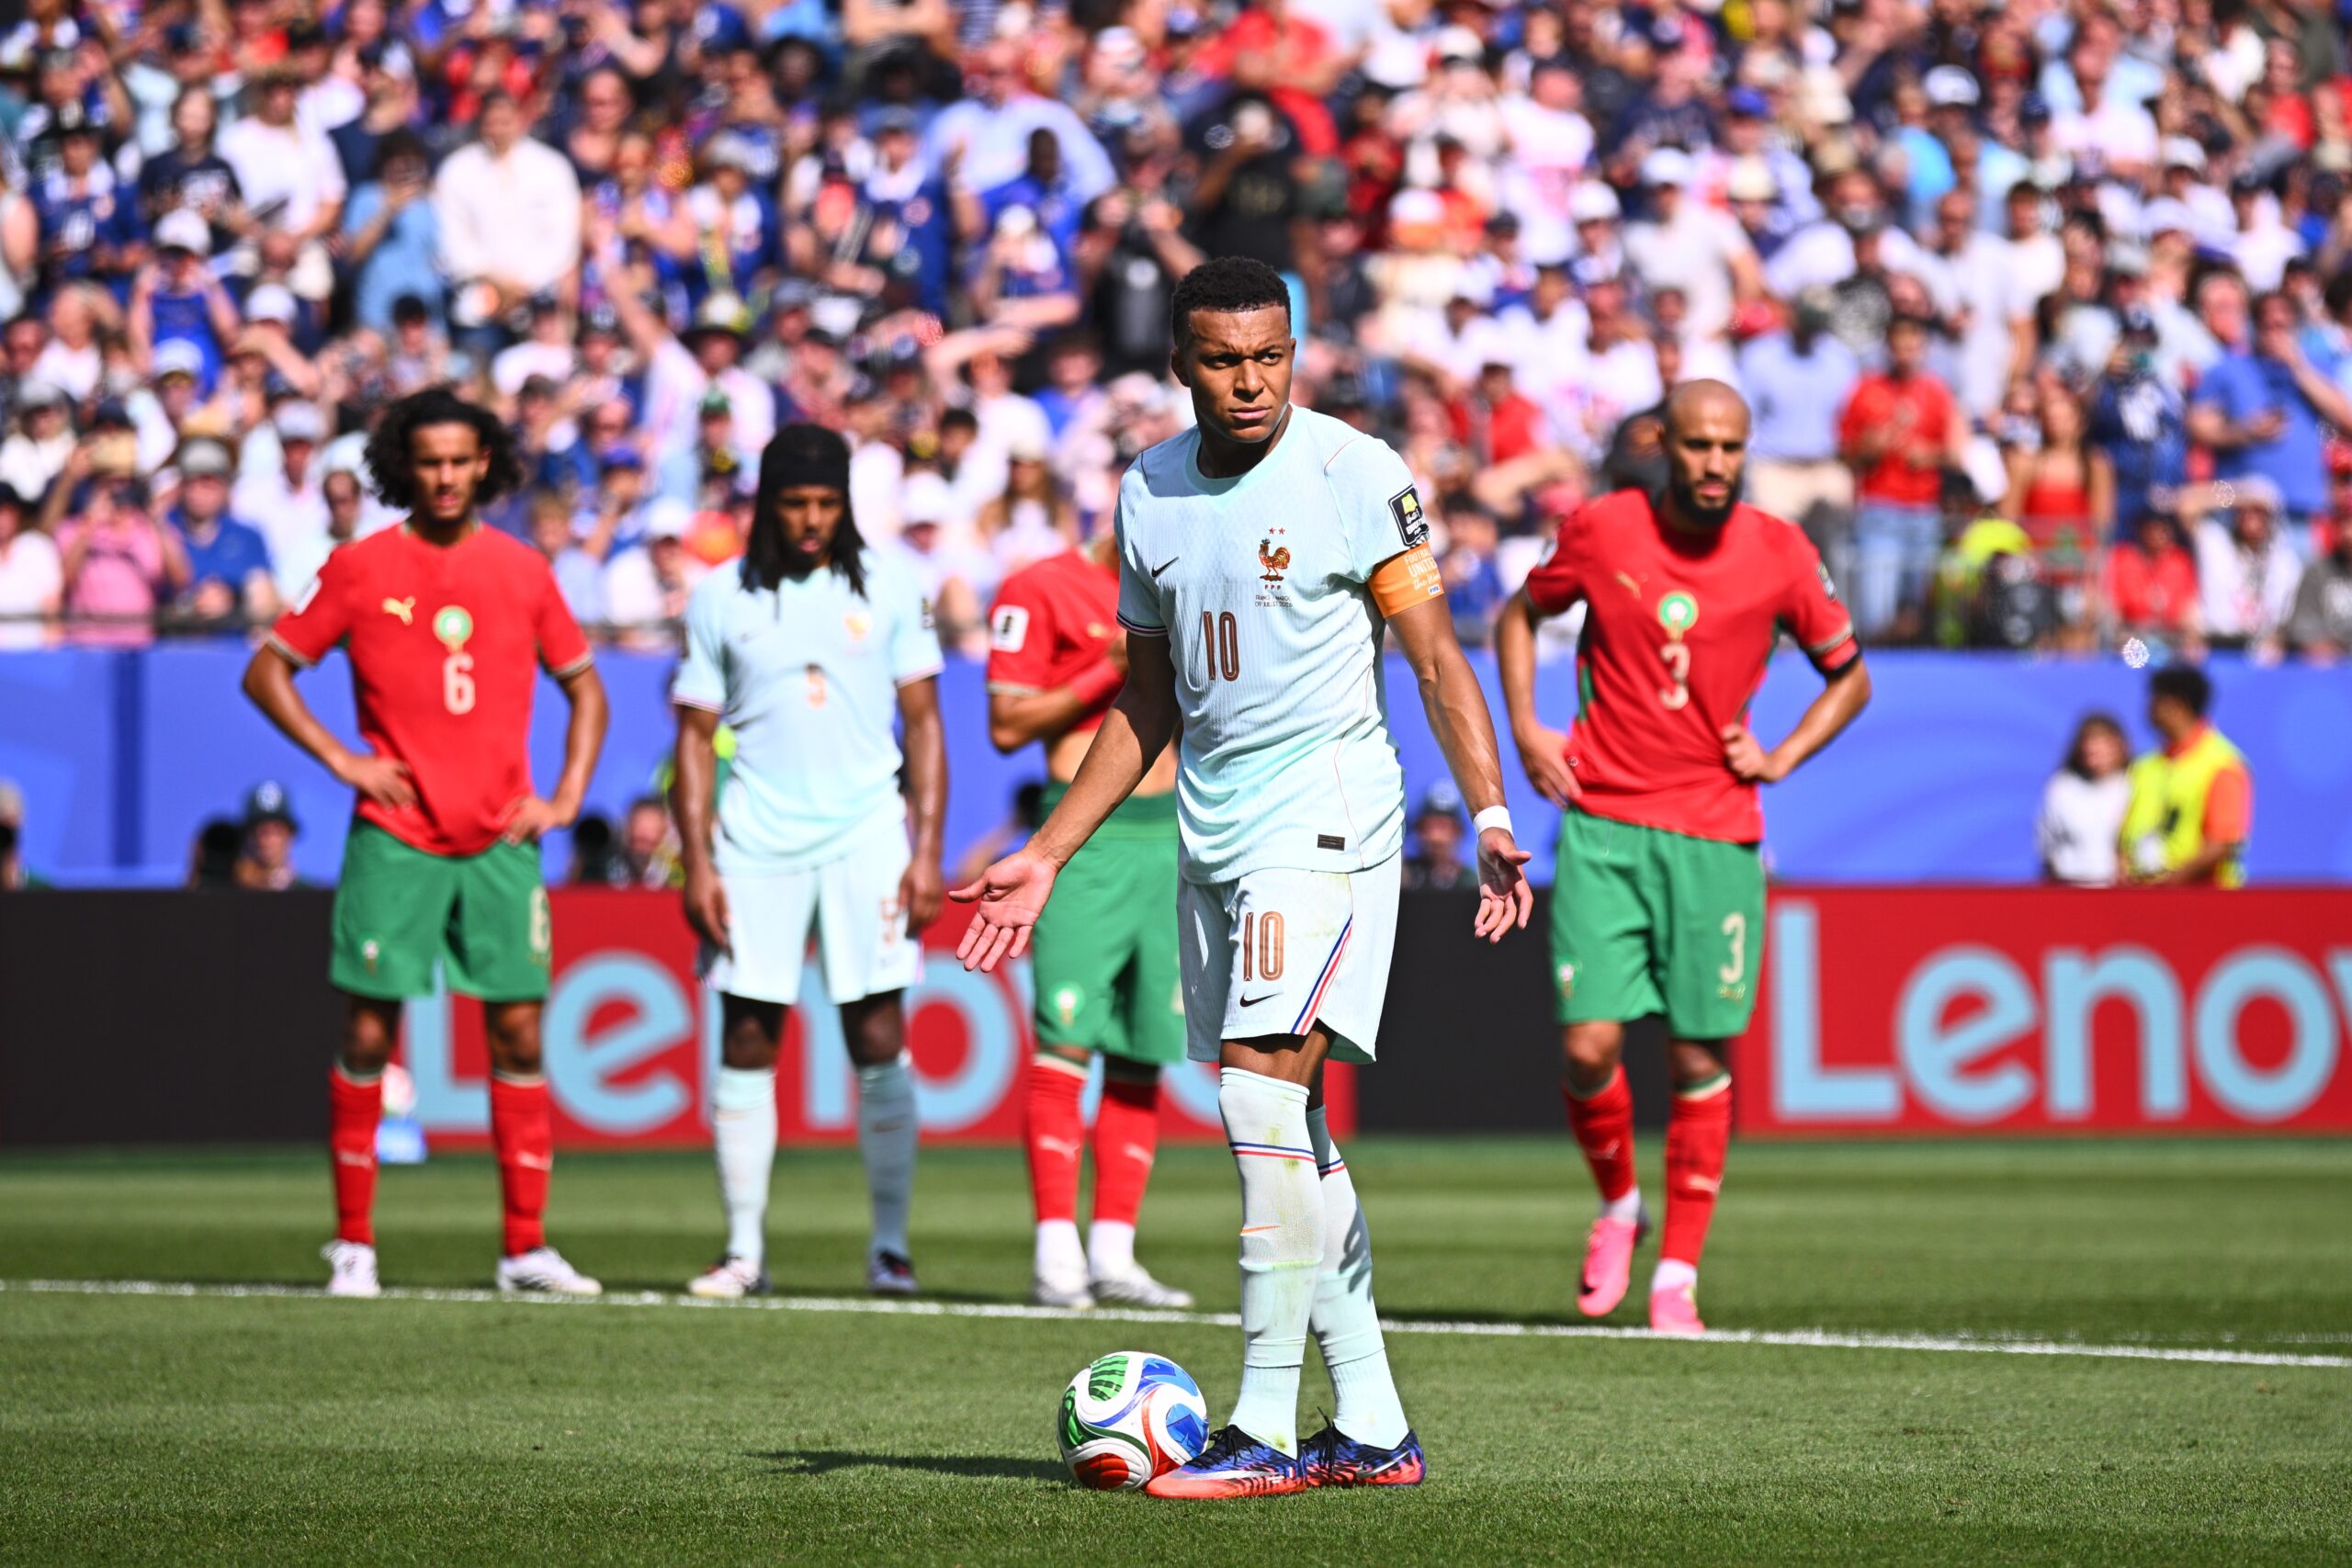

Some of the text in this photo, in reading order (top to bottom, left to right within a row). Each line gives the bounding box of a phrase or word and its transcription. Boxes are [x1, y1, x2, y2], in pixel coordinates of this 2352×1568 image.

[1203, 611, 1239, 682] 10
[1660, 642, 1690, 710] 3
[443, 651, 476, 716] 6
[1243, 911, 1284, 982] 10
[1720, 912, 1746, 985] 3
[1770, 898, 2352, 1126] Leno
